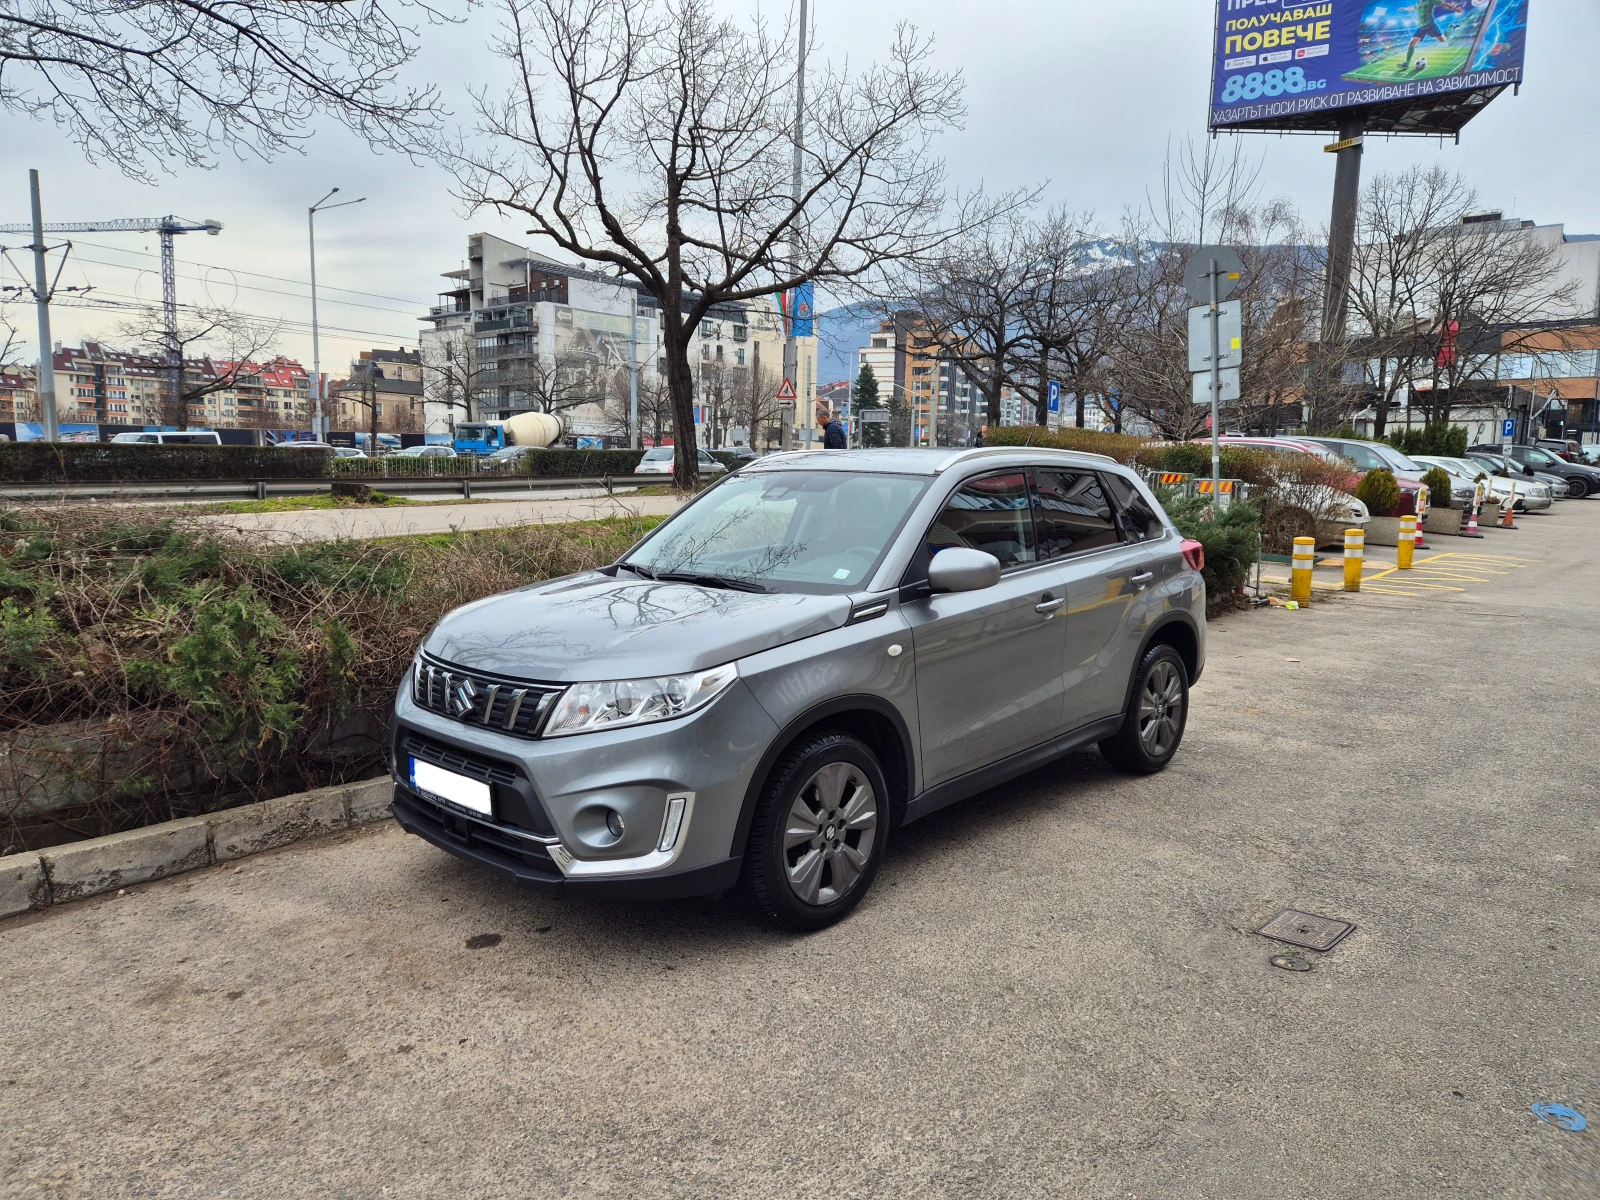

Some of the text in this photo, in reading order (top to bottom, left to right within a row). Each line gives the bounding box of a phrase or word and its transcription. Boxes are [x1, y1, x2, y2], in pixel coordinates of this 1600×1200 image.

[1225, 3, 1332, 32] ПОЛУЧАВАШ
[1225, 20, 1331, 54] ПОВЕЧЕ
[1212, 66, 1522, 123] ХАЗАРТЪТ НОСИ РИСК ОТ РАЗВИВАНЕ НА ЗАВИСИМОСТ
[1051, 384, 1058, 407] P
[1505, 421, 1512, 434] P
